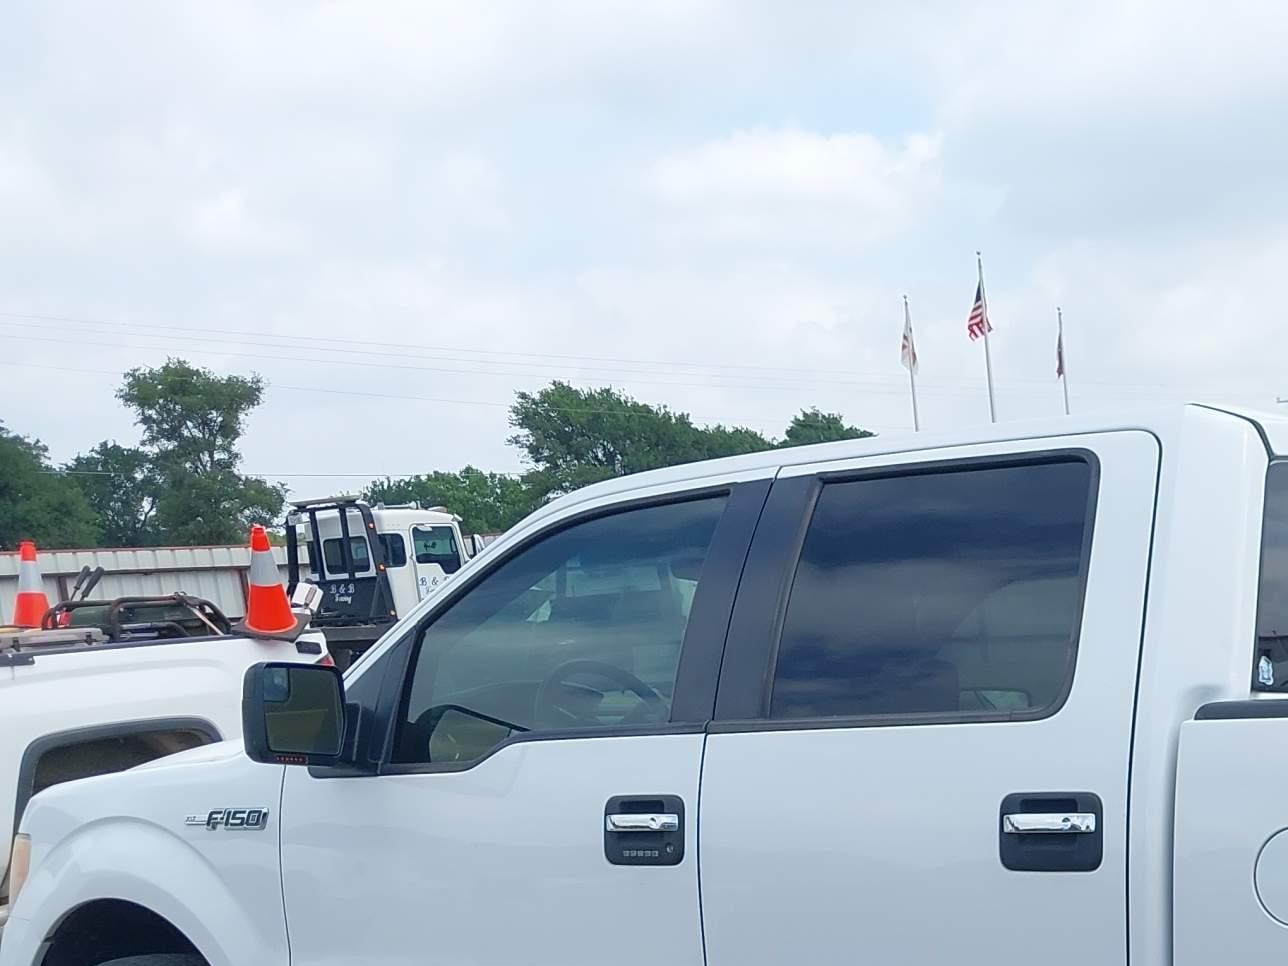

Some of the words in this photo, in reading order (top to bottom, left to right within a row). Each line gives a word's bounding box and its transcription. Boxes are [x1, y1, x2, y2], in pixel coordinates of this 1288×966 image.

[329, 583, 337, 594] B
[339, 583, 346, 594] &
[347, 583, 355, 594] B
[205, 809, 267, 829] F-150
